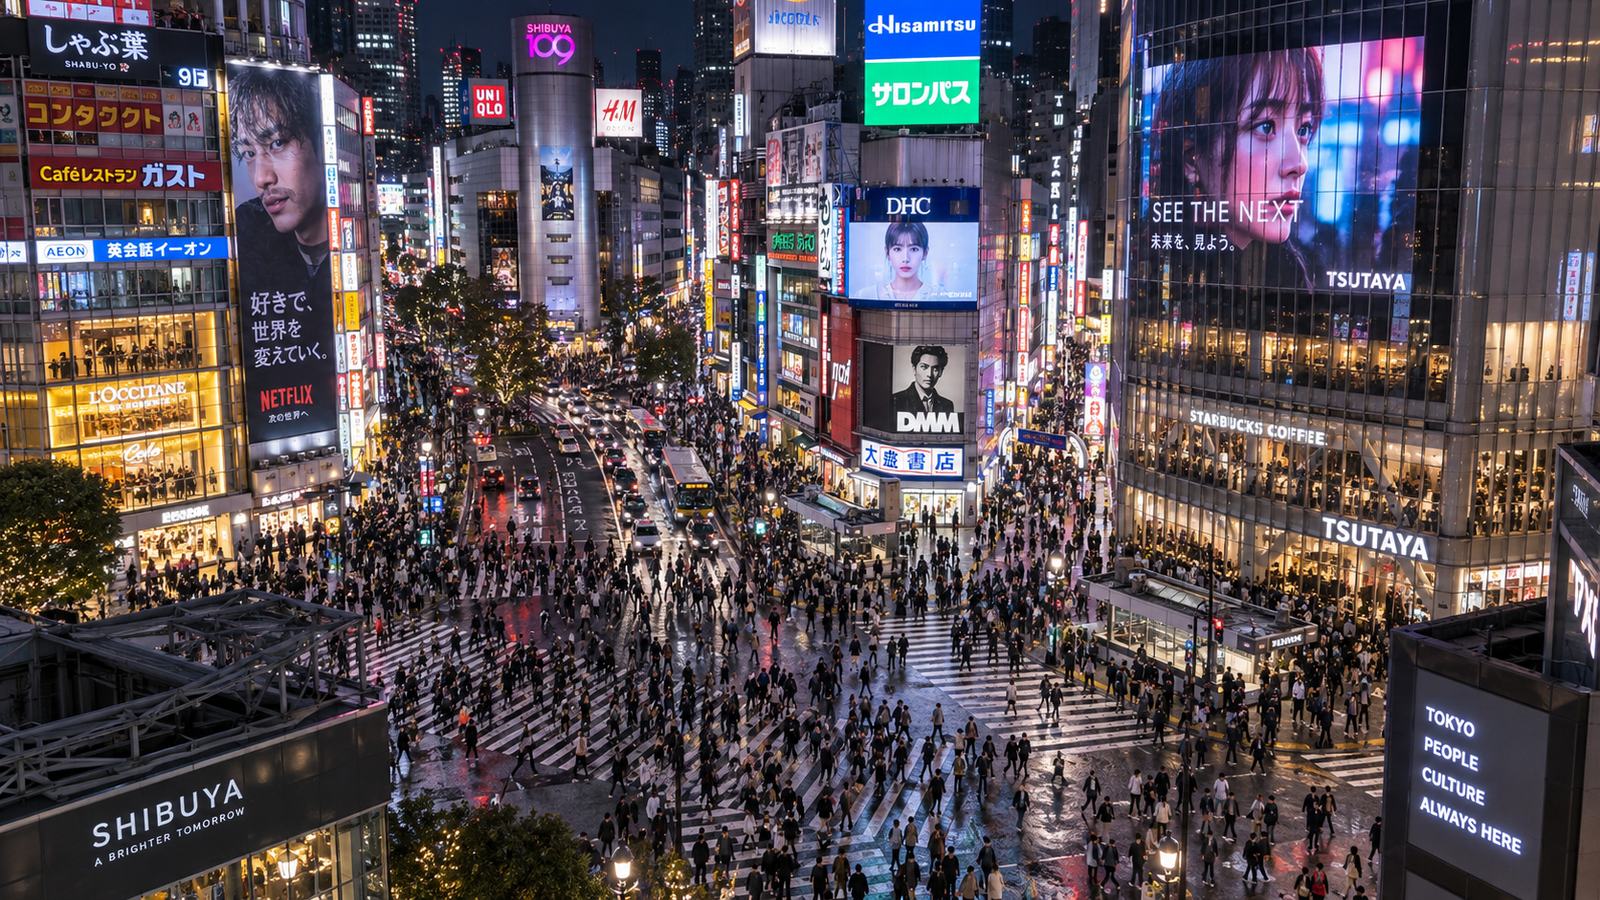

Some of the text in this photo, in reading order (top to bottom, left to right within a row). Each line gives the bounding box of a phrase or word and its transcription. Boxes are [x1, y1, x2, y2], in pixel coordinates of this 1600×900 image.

[526, 23, 572, 34] SHIBUYA
[868, 14, 977, 34] Hisamitsu
[44, 24, 149, 60] しゃぶ葉
[525, 33, 576, 66] 109
[64, 60, 117, 71] SHABU-YO
[178, 67, 209, 87] 9F
[476, 89, 500, 101] UNI
[871, 81, 971, 106] サロンパス
[476, 103, 503, 115] QLO
[602, 99, 637, 123] H&M
[142, 162, 205, 188] ガスト
[886, 197, 931, 215] DHC
[1152, 200, 1304, 223] SEE THE NEXT
[46, 246, 85, 257] AEON
[1150, 233, 1235, 252] 未来を、見よう。
[1326, 271, 1407, 291] TSUTAYA
[250, 290, 313, 316] 好きで、
[251, 318, 302, 343] 世界を
[254, 341, 328, 368] 変えていく。
[88, 381, 187, 405] L'OCCITANE
[260, 384, 314, 412] NETFLIX
[896, 411, 960, 433] DMM
[1190, 410, 1264, 436] STARBUCKS
[1322, 517, 1429, 561] TSUTAYA
[1426, 705, 1476, 738] TOKYO
[1424, 736, 1479, 772] PEOPLE
[1421, 767, 1486, 806] CULTURE
[92, 779, 243, 848] SHIBUYA
[1419, 797, 1522, 855] ALWAYS HERE
[94, 807, 245, 867] A BRIGHTER TOMORROW
